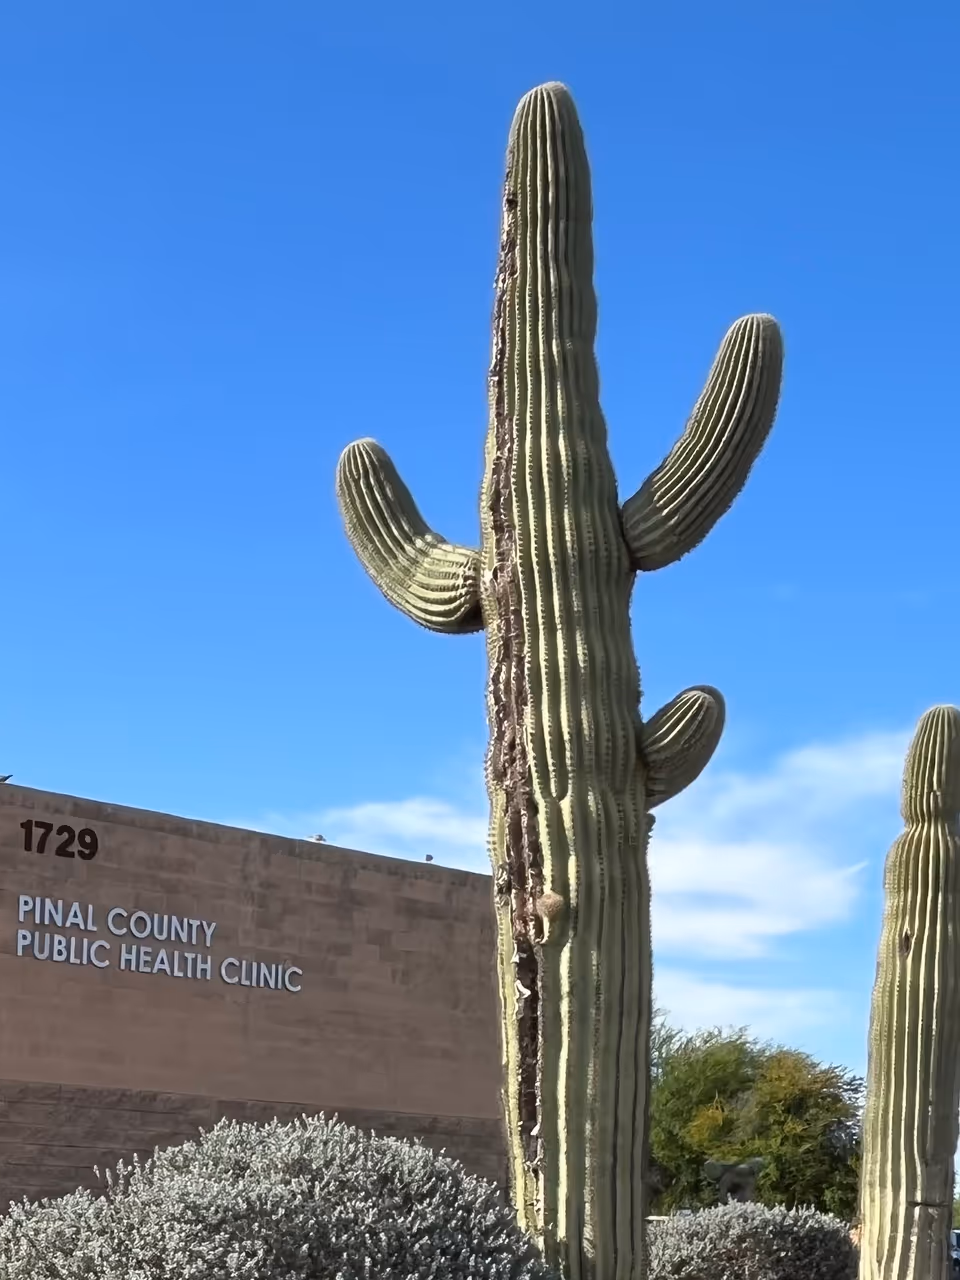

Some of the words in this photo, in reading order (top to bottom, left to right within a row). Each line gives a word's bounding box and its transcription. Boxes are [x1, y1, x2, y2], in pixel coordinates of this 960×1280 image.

[20, 819, 98, 860] 1729
[18, 895, 97, 932] PINAL
[107, 907, 216, 947] COUNTY
[16, 929, 110, 968] PUBLIC
[120, 943, 211, 980] HEALTH
[220, 957, 303, 992] CLINIC
